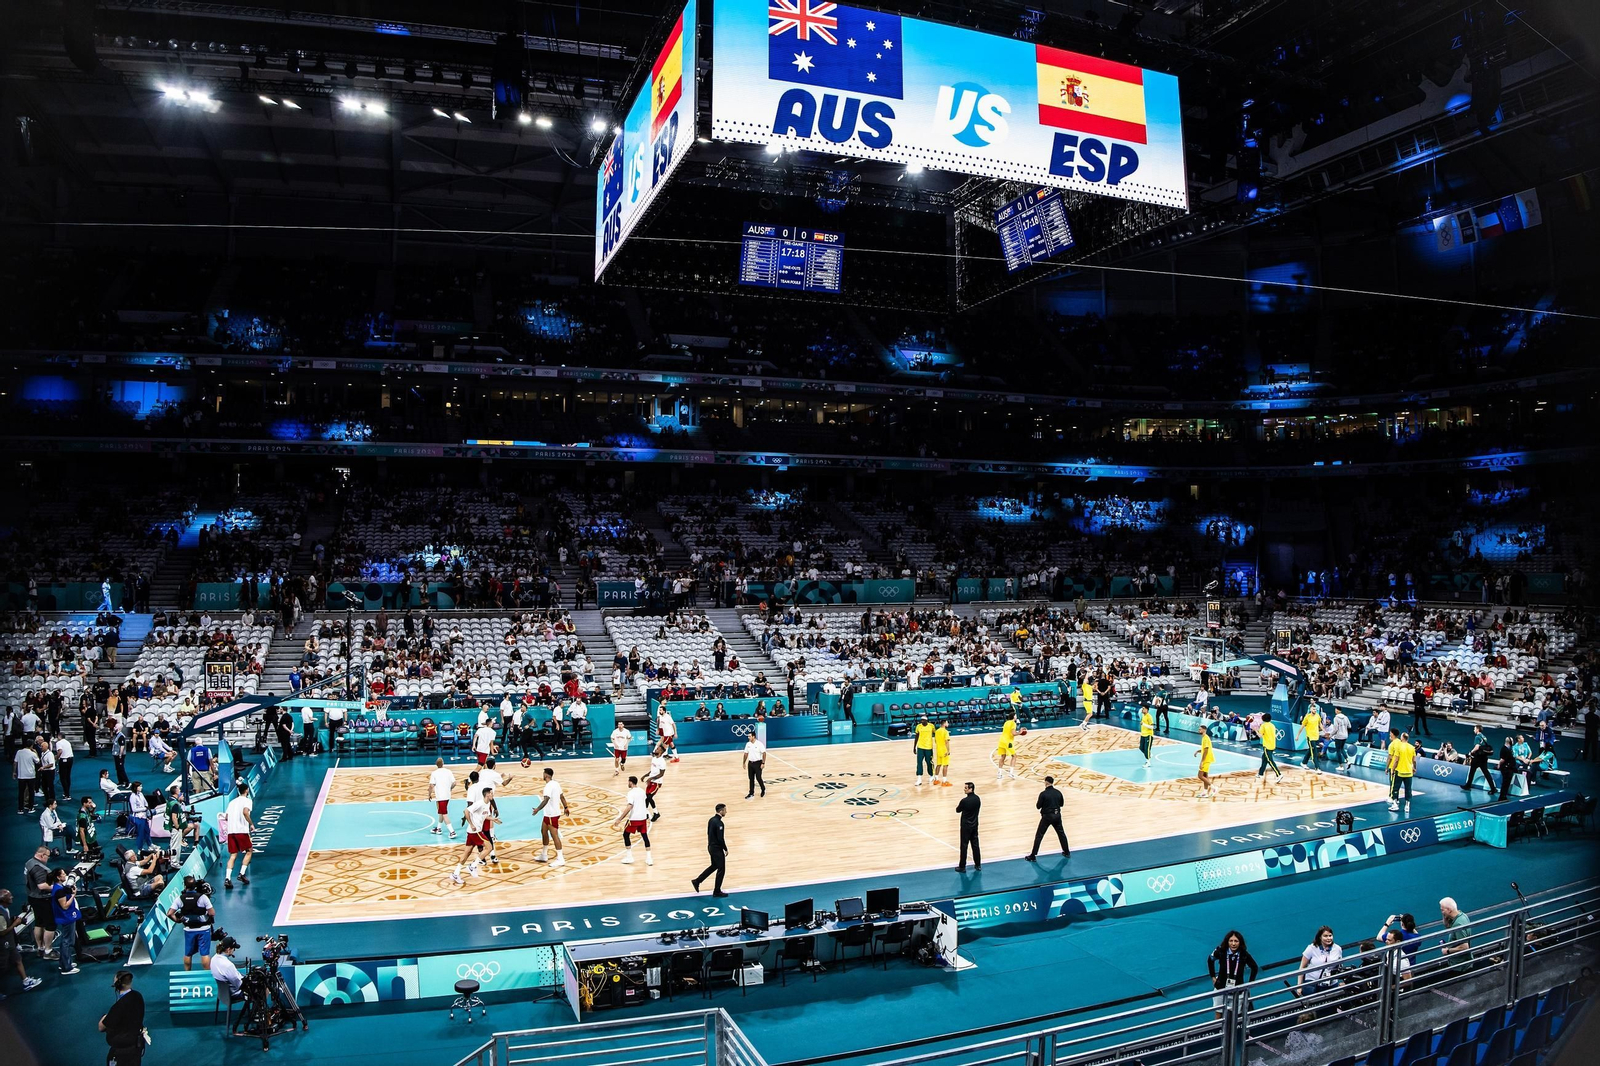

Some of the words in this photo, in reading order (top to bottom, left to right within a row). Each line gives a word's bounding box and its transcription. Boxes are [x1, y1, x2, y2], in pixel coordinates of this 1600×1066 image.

[773, 88, 896, 149] AUS
[932, 85, 1012, 146] VS
[1048, 132, 1139, 186] ESP
[603, 202, 621, 262] AUS
[652, 111, 678, 189] ESP
[748, 226, 764, 234] AUS
[1023, 216, 1039, 230] 17:18
[781, 248, 805, 258] 17:18
[195, 592, 230, 601] ARIS
[257, 806, 286, 825] 2024
[1440, 822, 1461, 832] PARIS
[1211, 828, 1294, 846] PARIS
[1203, 868, 1232, 879] PARIS
[1235, 862, 1261, 874] 2024
[963, 906, 1000, 920] PARIS
[1004, 901, 1037, 914] 2024
[491, 916, 621, 936] PARIS
[181, 986, 213, 998] PAR
